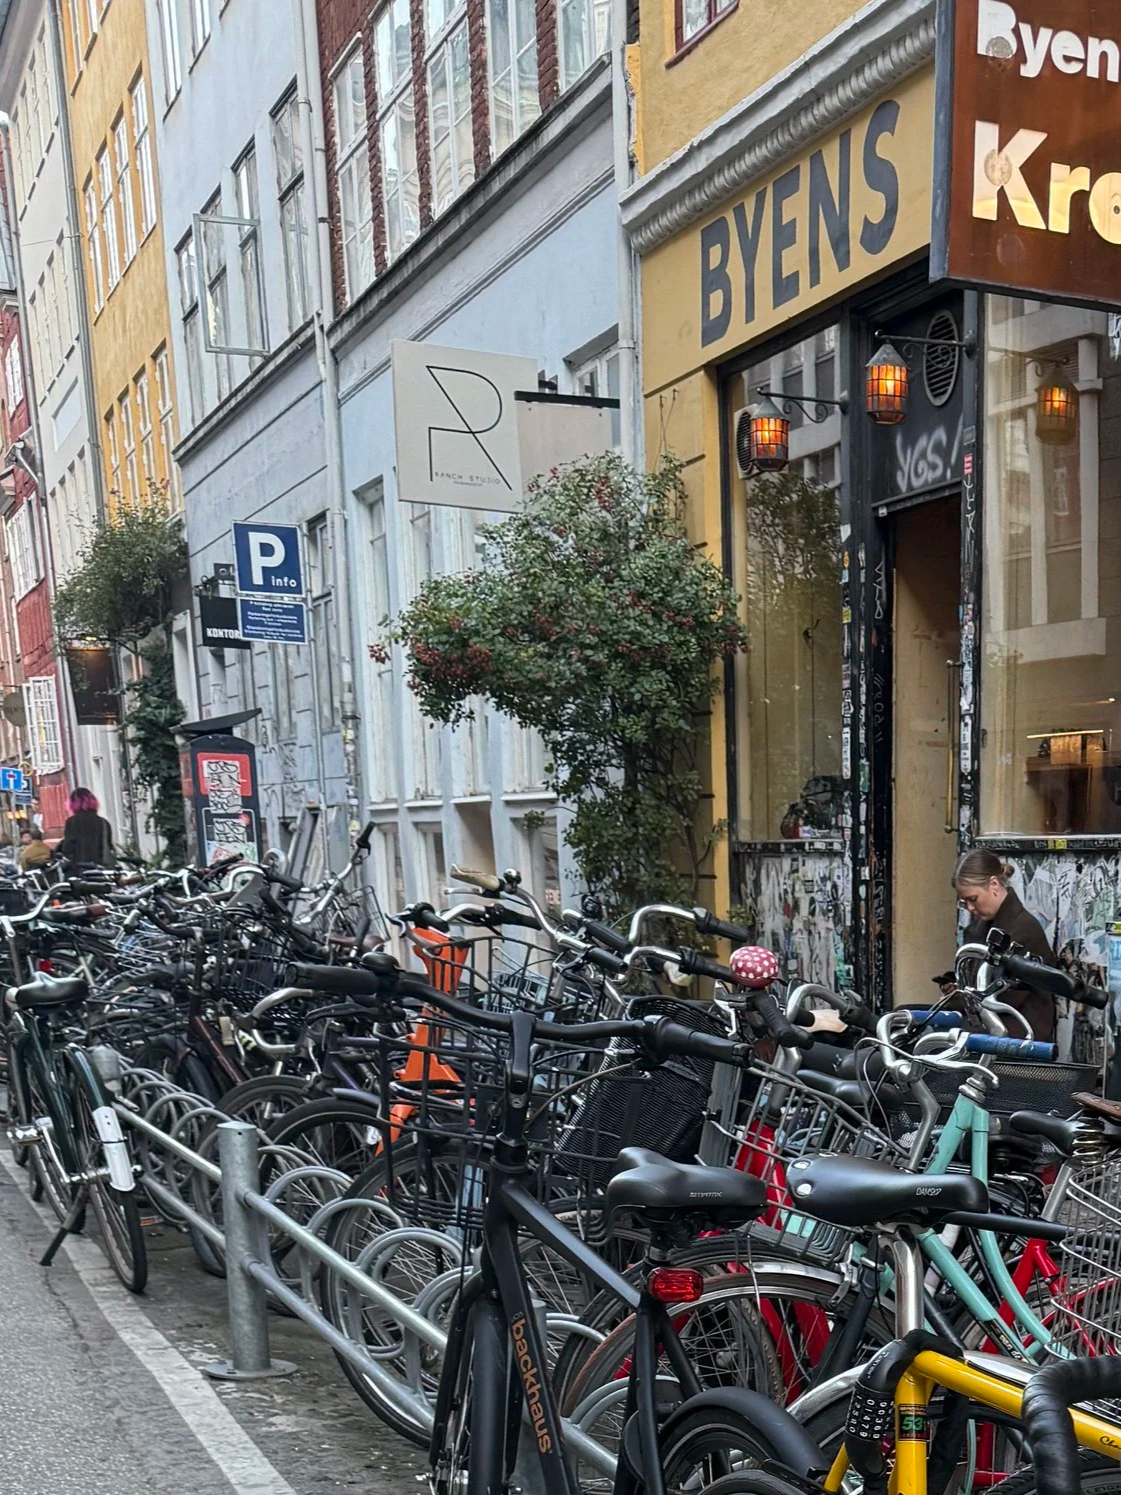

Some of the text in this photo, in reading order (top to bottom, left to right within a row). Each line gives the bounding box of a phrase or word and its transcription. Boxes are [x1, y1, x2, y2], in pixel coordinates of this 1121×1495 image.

[700, 100, 900, 348] BYENS
[248, 531, 286, 586] P
[271, 576, 297, 588] info
[206, 627, 242, 639] KONTOR
[511, 1318, 553, 1454] backhaus
